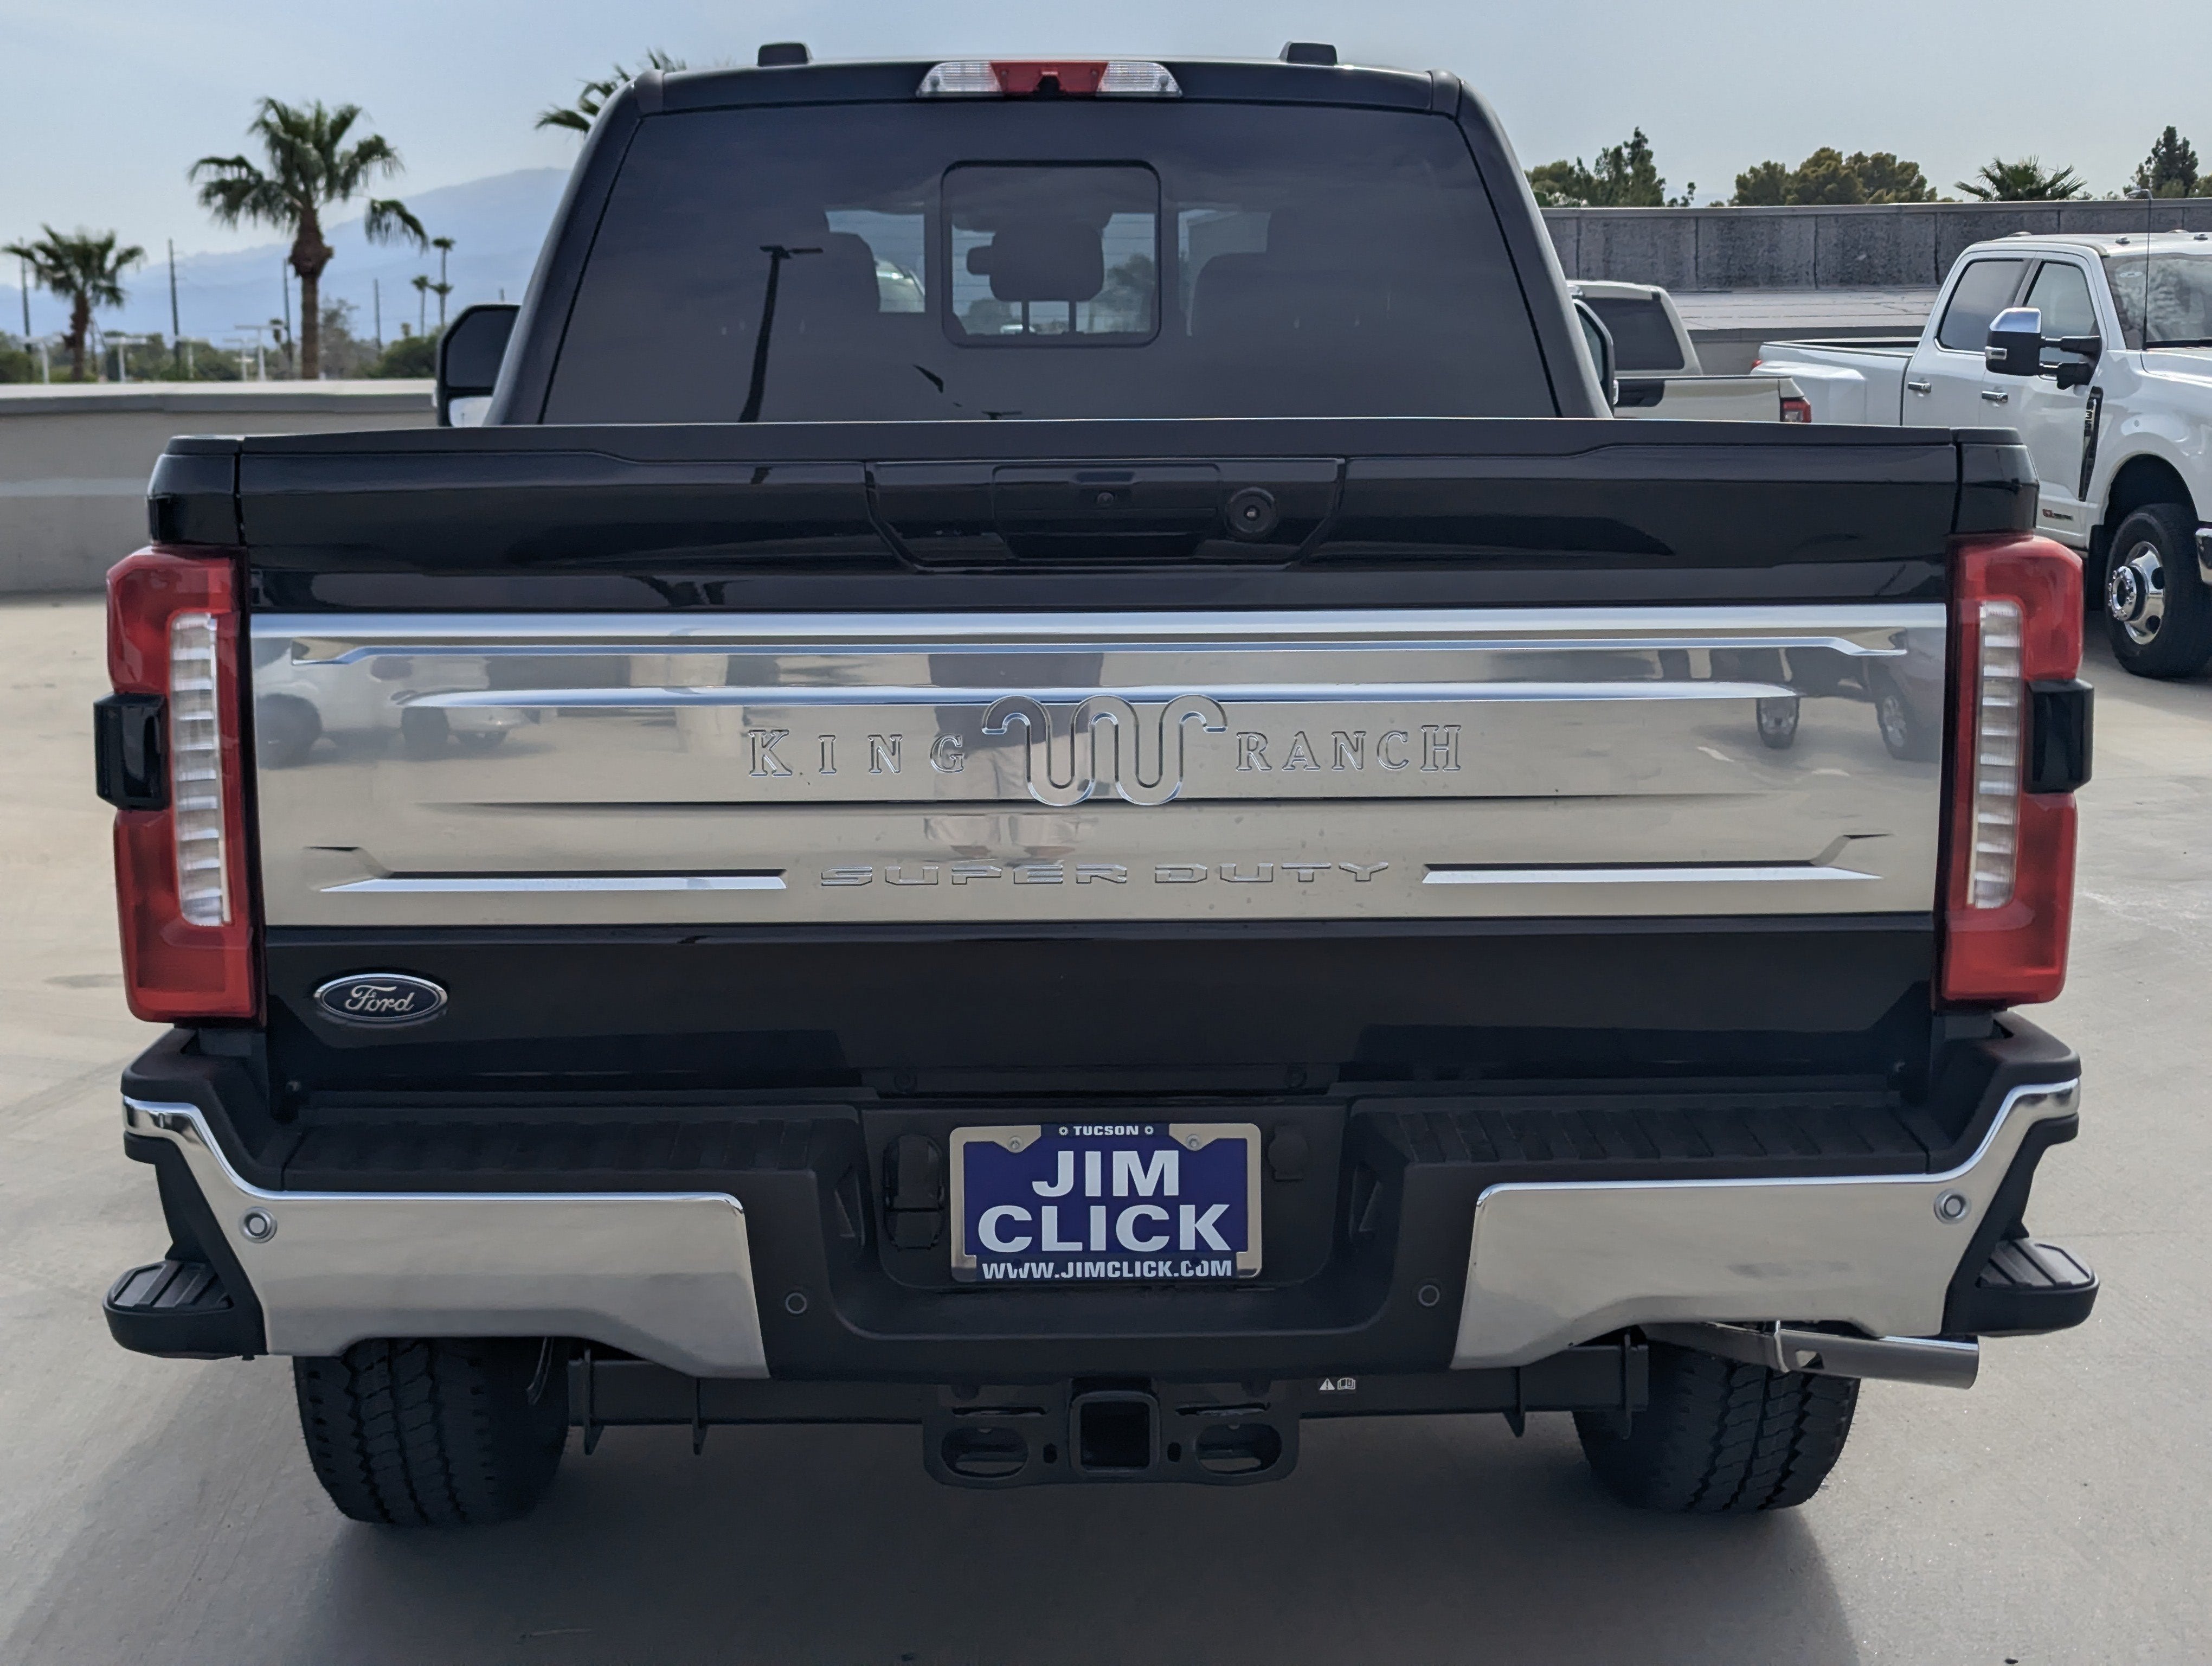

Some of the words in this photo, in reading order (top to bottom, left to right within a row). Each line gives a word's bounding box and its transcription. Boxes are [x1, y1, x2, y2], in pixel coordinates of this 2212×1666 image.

[748, 729, 965, 777] KING
[1236, 725, 1462, 772] RANCH
[821, 863, 1127, 886] SUPER
[1154, 862, 1389, 884] DUTY
[345, 984, 415, 1012] Ford
[1073, 1125, 1139, 1136] TUCSON
[1032, 1150, 1179, 1197] JIM
[978, 1203, 1231, 1253] CLICK
[982, 1259, 1232, 1279] WWW.JIMCLICK.COM
